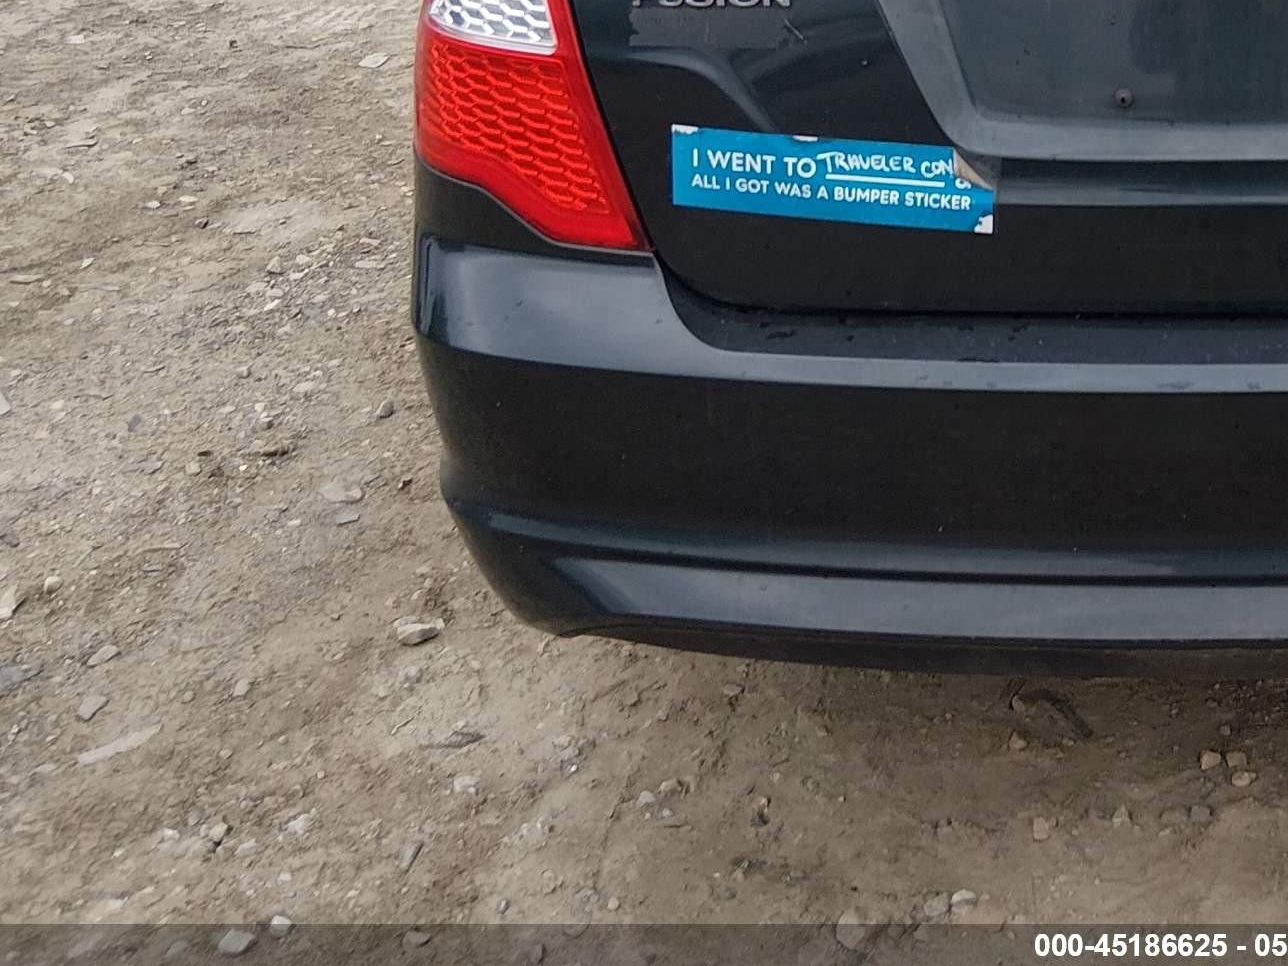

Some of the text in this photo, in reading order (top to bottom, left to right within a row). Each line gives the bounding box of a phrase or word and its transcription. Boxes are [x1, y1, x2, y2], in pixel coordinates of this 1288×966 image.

[692, 148, 699, 168] I
[706, 149, 776, 174] WENT
[783, 156, 817, 178] TO
[816, 151, 916, 174] TRAVELER
[691, 173, 972, 210] ALL I GOT WAS A BUMPER STICKER
